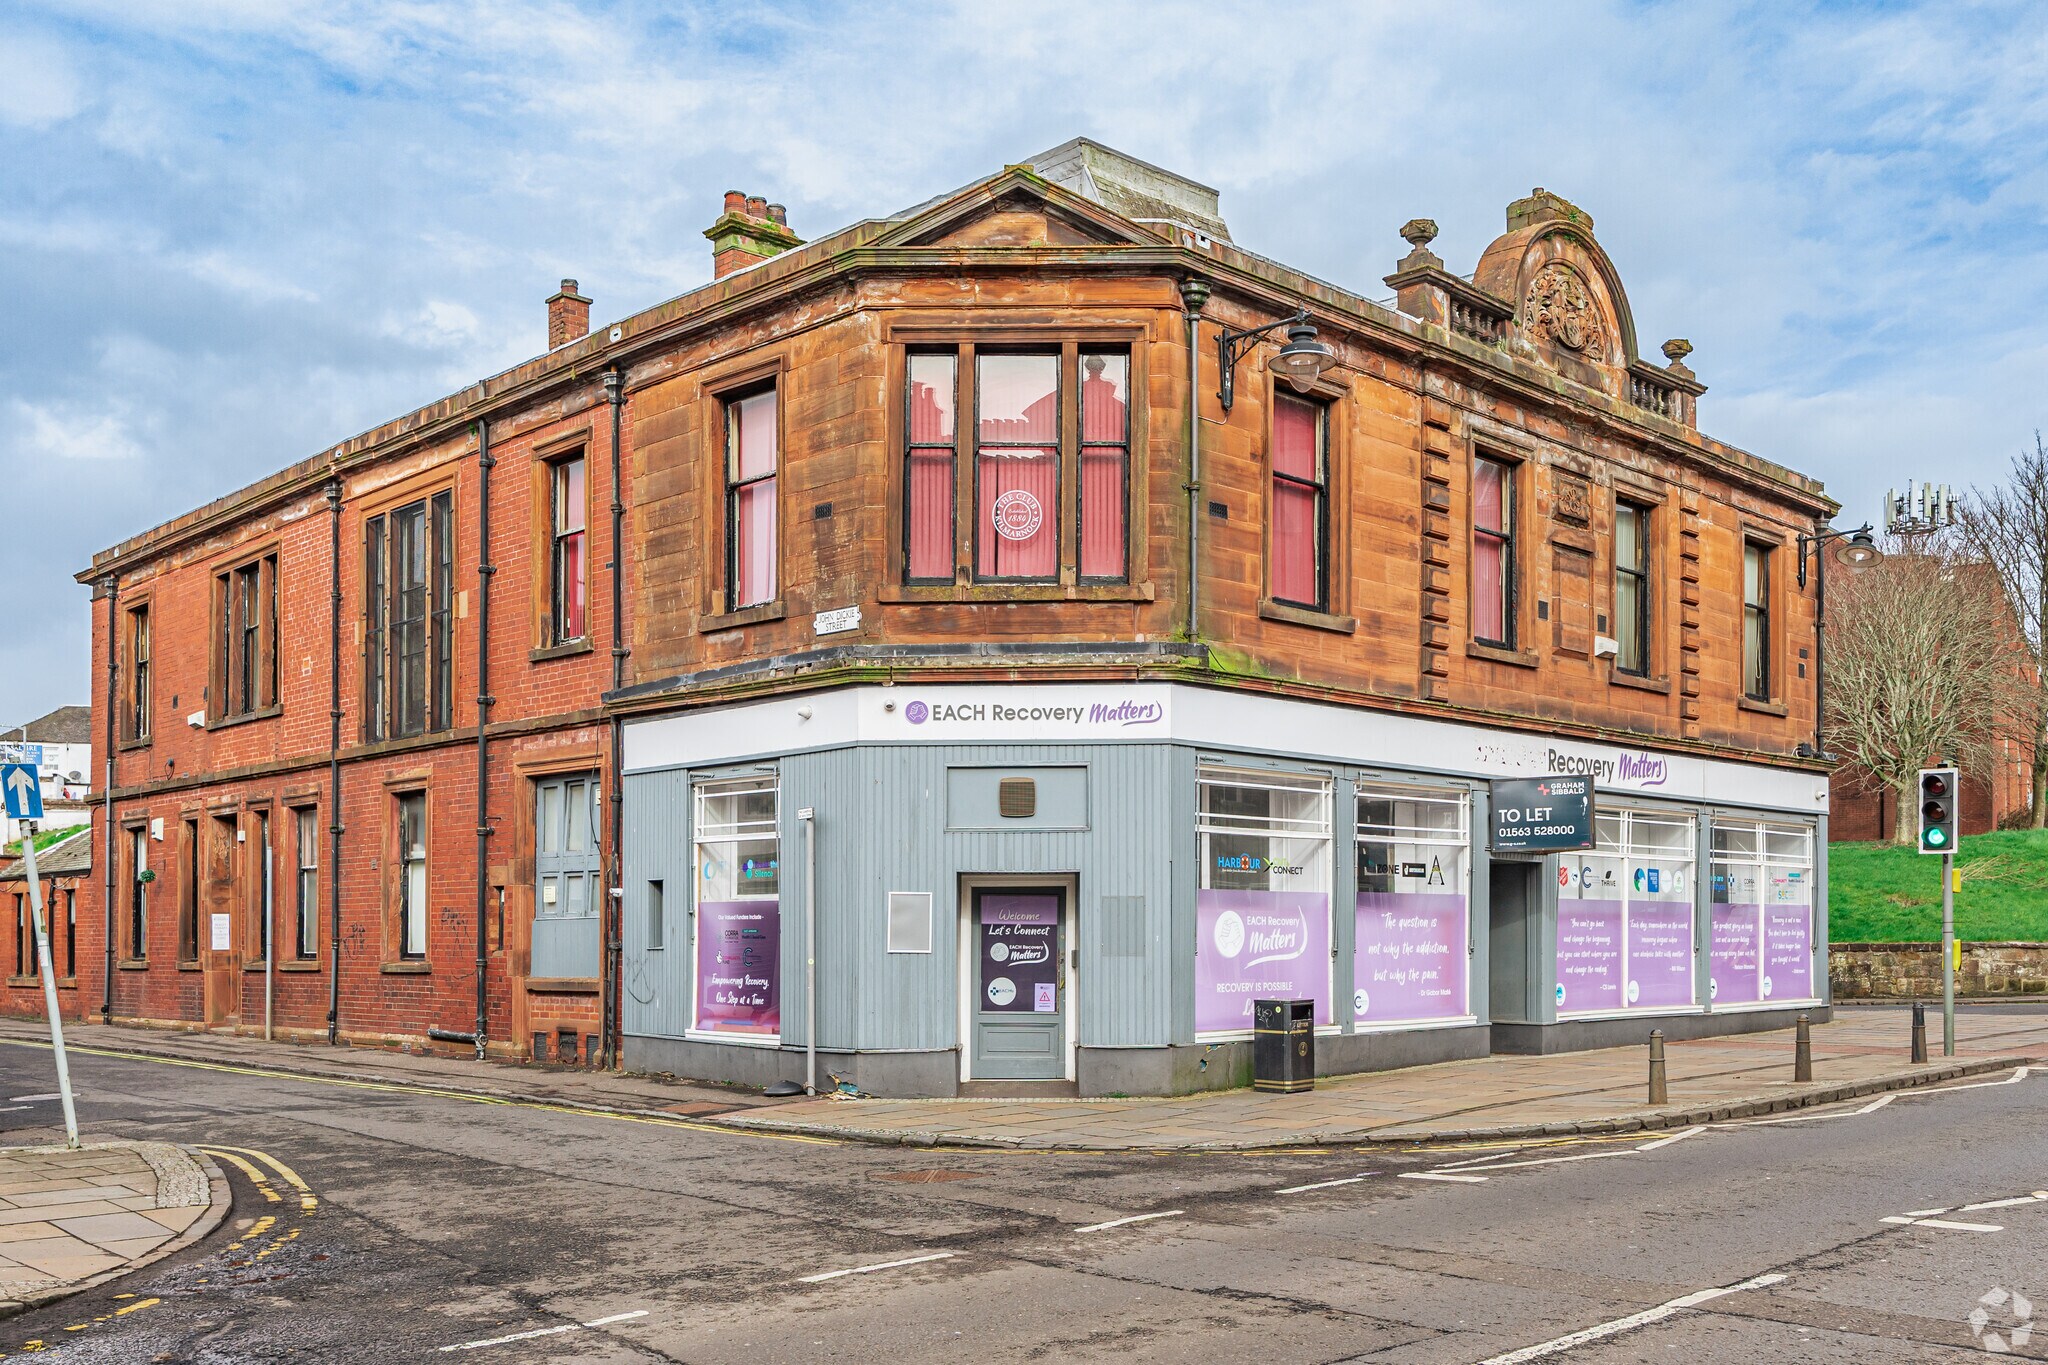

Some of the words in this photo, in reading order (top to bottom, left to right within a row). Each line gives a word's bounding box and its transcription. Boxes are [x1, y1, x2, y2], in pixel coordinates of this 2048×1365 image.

[997, 494, 1014, 509] THE
[1016, 493, 1037, 510] CLUB
[995, 516, 1040, 537] KILMARNOCK
[819, 612, 834, 623] JOHN
[836, 609, 855, 620] DICKIE
[825, 620, 847, 631] STREET
[932, 704, 985, 721] EACH
[992, 704, 1084, 723] Recovery
[1089, 700, 1159, 725] Matters
[1548, 748, 1614, 783] Recovery
[1618, 752, 1666, 784] Matters
[1551, 788, 1584, 796] SIBBALD
[1498, 809, 1521, 823] TO
[1526, 807, 1552, 822] LET
[1498, 827, 1531, 837] 01563
[1533, 825, 1575, 837] 528000
[1218, 853, 1260, 870] HARBOUR
[1377, 864, 1399, 874] ZONE
[1273, 866, 1303, 875] CONNECT
[998, 908, 1040, 921] Welcome
[1247, 916, 1266, 925] EACH
[1267, 916, 1300, 928] Recovery
[989, 924, 1011, 935] Let's
[1014, 924, 1050, 936] Connect
[1398, 916, 1429, 931] question
[1430, 918, 1437, 928] is
[1249, 928, 1296, 954] Matters
[1011, 951, 1041, 961] Matters
[1368, 942, 1381, 955] not
[1383, 942, 1400, 960] why
[1402, 942, 1414, 955] the
[712, 973, 743, 989] Empowering
[1374, 969, 1388, 981] but
[1389, 968, 1405, 985] why
[1408, 968, 1420, 981] the
[1216, 983, 1254, 993] RECOVERY
[1255, 983, 1262, 991] IS
[1263, 982, 1293, 991] POSSIBLE
[716, 992, 726, 1003] One
[727, 991, 738, 1007] Step
[739, 996, 745, 1005] at
[752, 993, 764, 1005] Time
